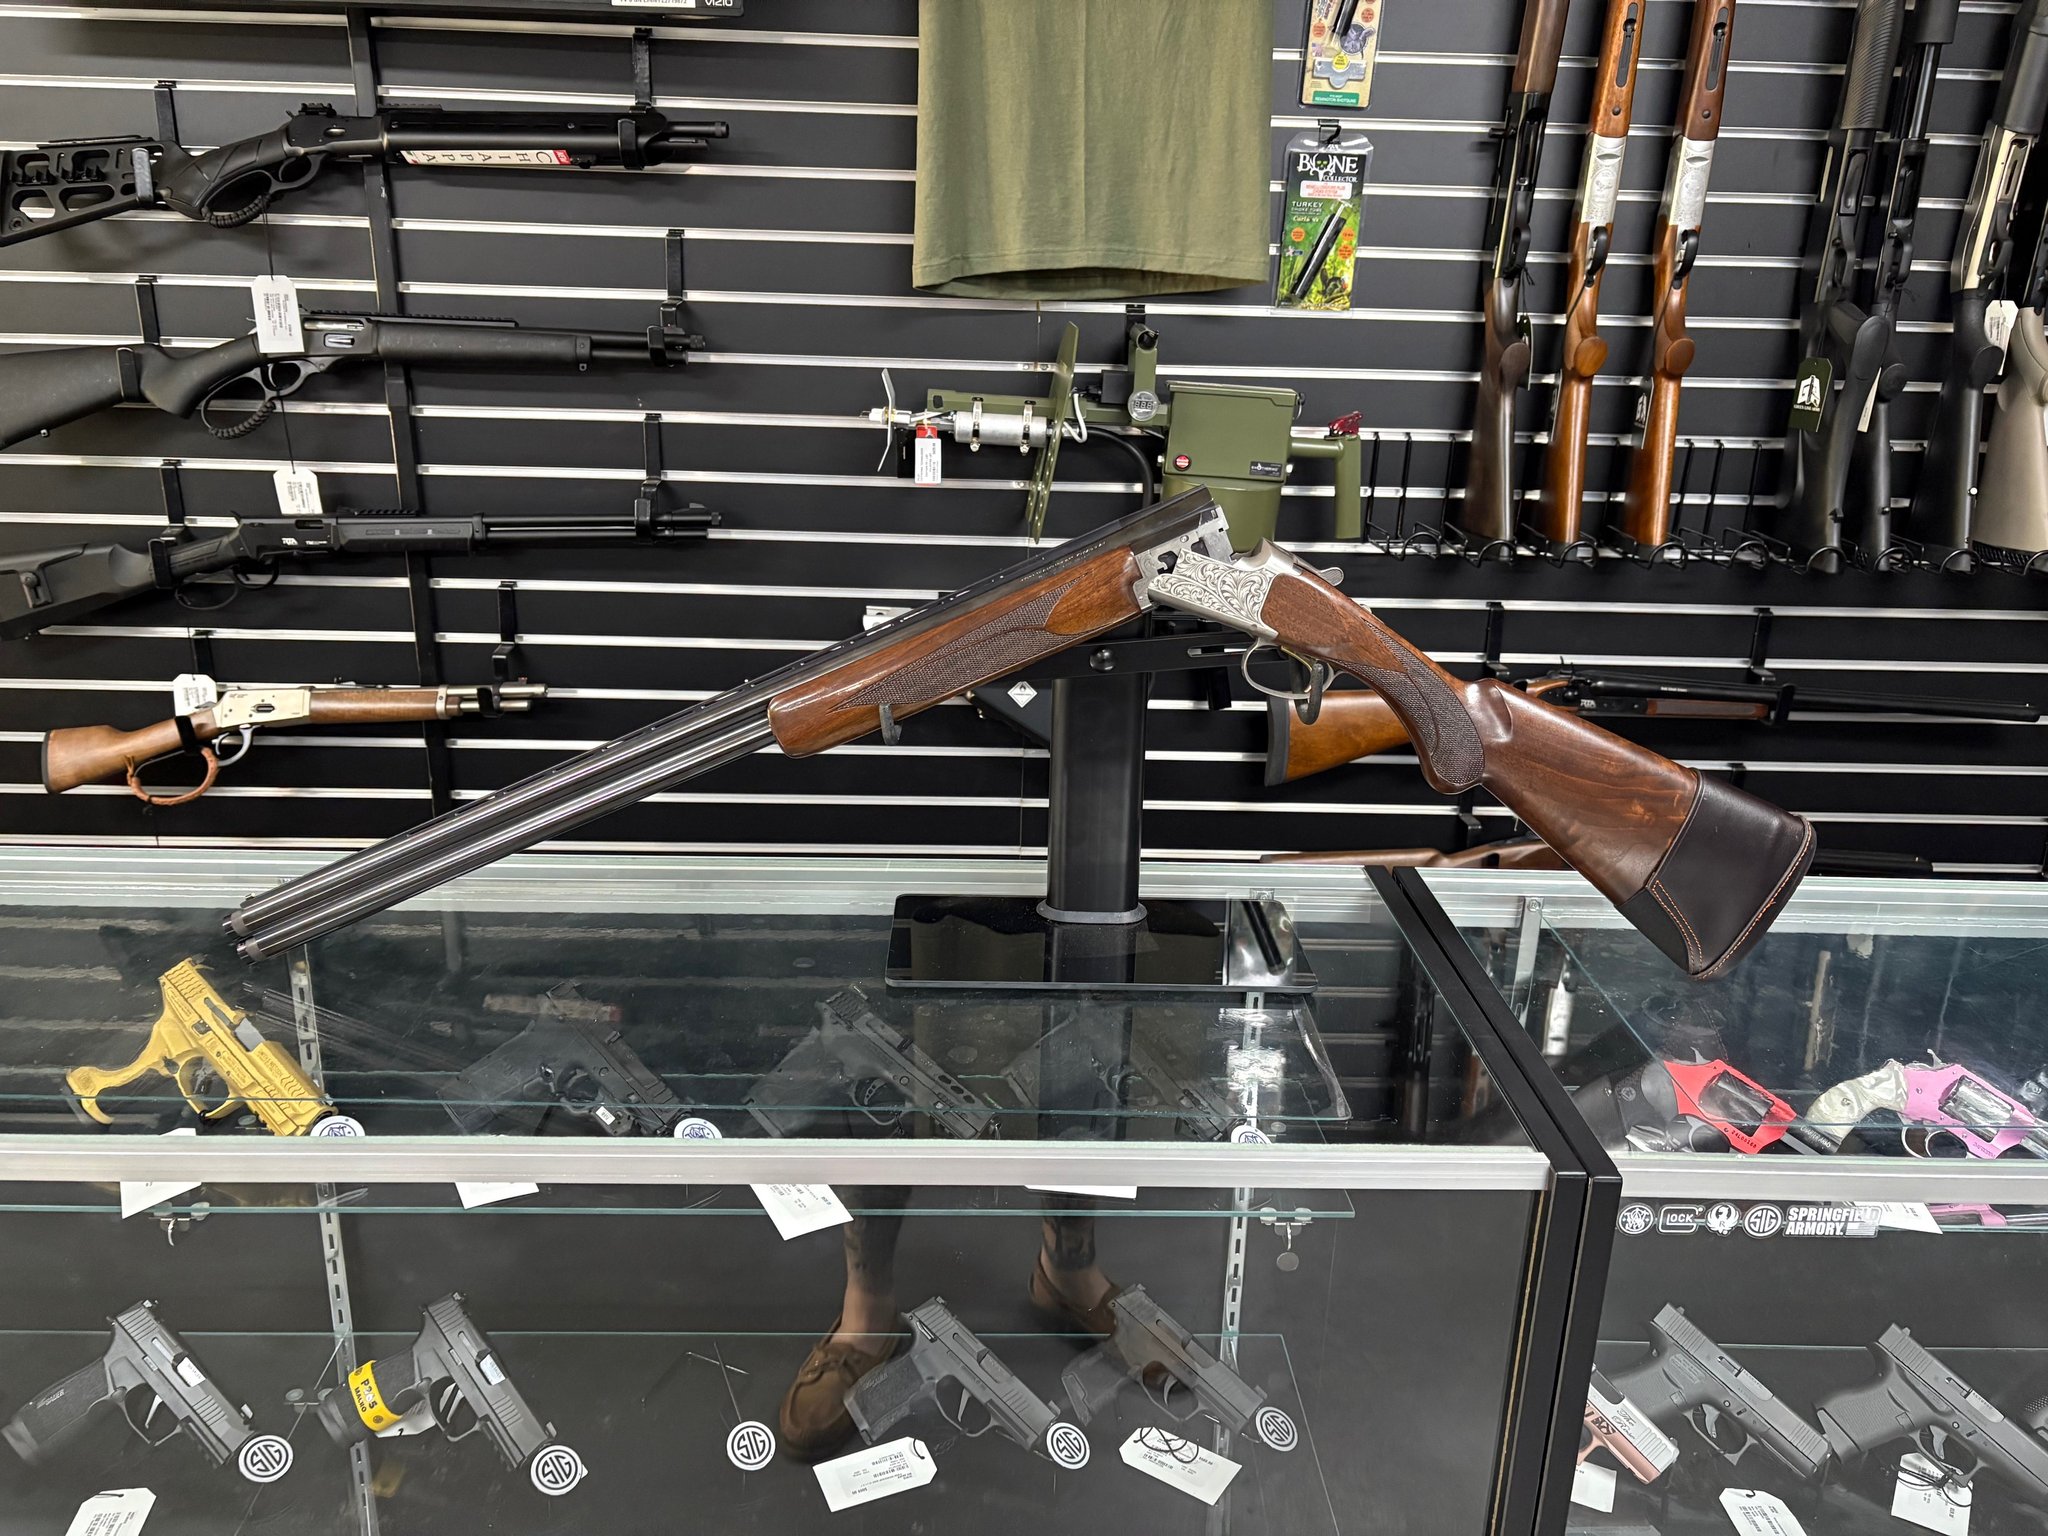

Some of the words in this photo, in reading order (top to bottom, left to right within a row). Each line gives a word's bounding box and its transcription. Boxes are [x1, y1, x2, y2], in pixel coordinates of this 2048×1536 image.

[1322, 174, 1359, 183] COLLECTOR
[1749, 1208, 1777, 1234] SIG
[1263, 1413, 1292, 1444] SIG
[249, 1442, 285, 1474] SIG
[736, 1430, 769, 1462] SIG
[1054, 1430, 1083, 1462] SIG
[540, 1452, 575, 1487] SIG
